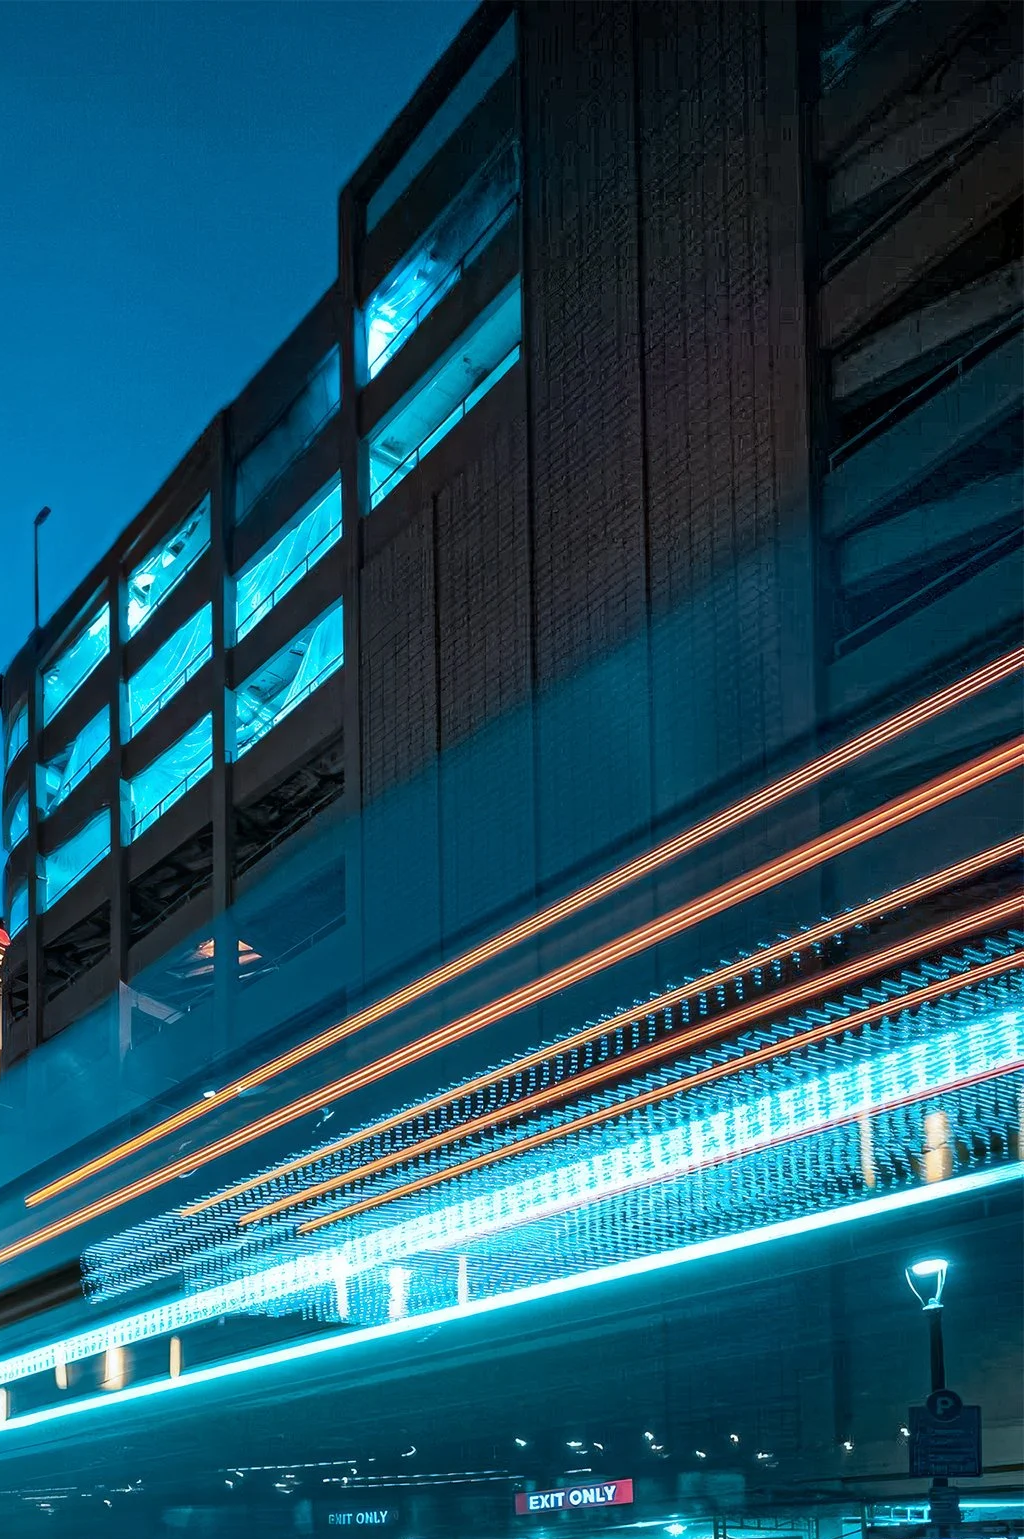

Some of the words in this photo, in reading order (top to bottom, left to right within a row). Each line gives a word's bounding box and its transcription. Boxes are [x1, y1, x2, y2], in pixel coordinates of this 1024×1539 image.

[936, 1396, 954, 1415] P
[528, 1492, 565, 1510] EXIT
[569, 1485, 616, 1506] ONLY
[356, 1510, 388, 1524] ONLY
